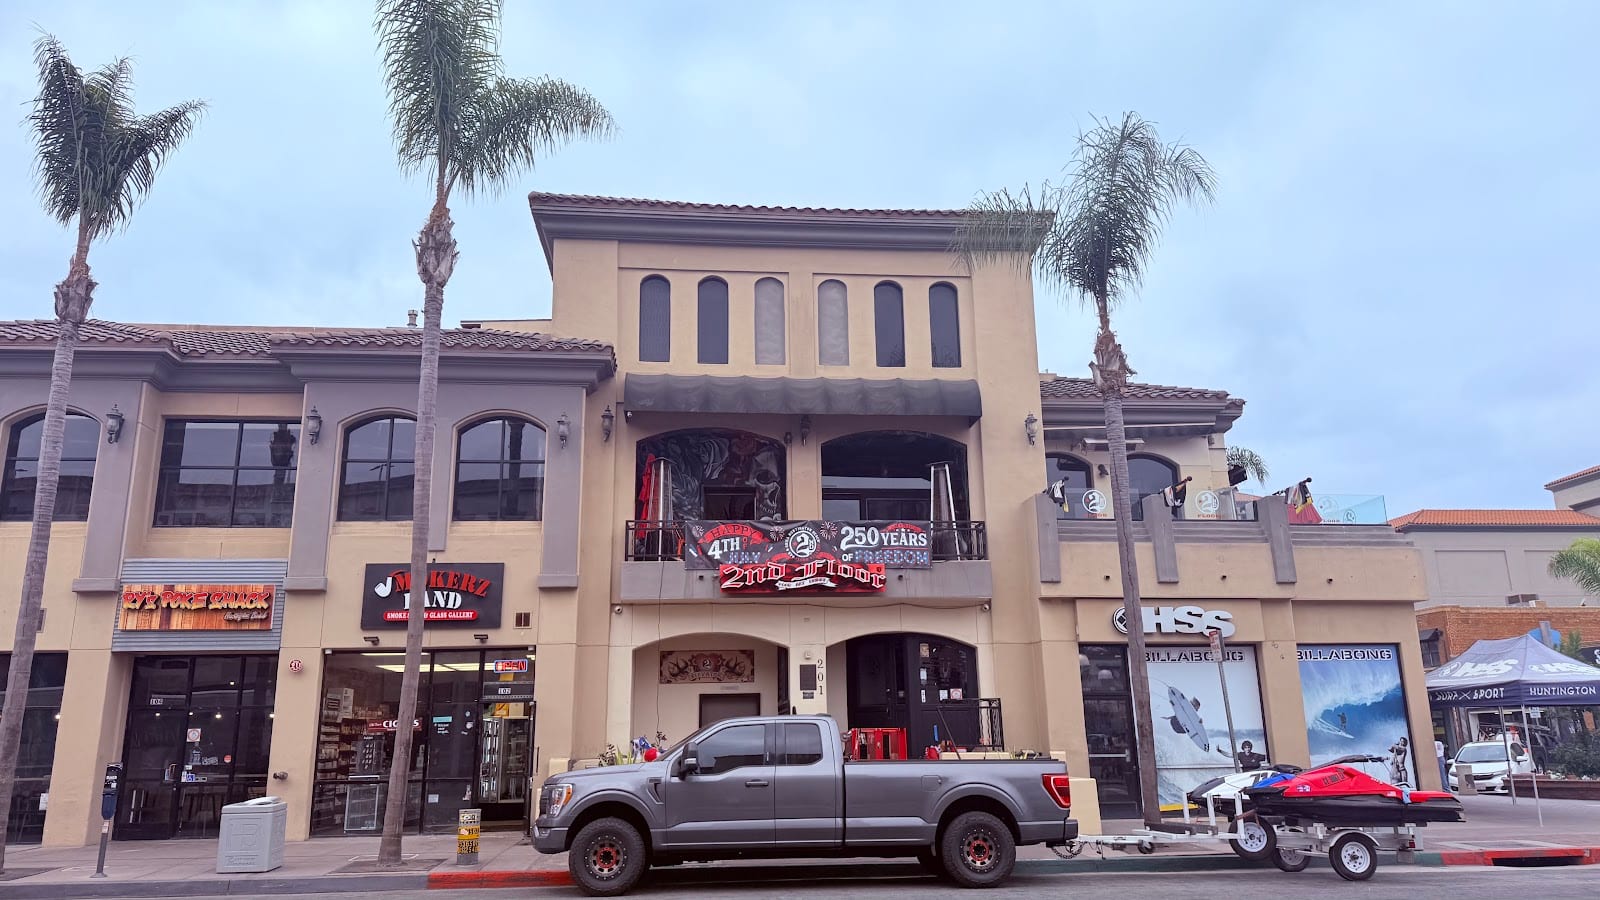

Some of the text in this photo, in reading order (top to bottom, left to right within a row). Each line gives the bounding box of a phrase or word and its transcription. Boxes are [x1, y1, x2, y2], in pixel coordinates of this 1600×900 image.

[710, 524, 757, 537] HAPPY
[840, 526, 879, 551] 250
[879, 532, 928, 547] YEARS
[708, 537, 740, 560] 4TH
[842, 550, 929, 565] OF FREEDOM
[720, 559, 887, 589] 2nd Floor
[160, 591, 207, 610] POKE
[208, 591, 270, 610] SHACK
[448, 611, 474, 619] GALLERY
[1141, 605, 1236, 638] HSS
[816, 658, 824, 696] 201
[1473, 687, 1505, 700] SPORT
[1529, 686, 1597, 696] HUNTINGTON
